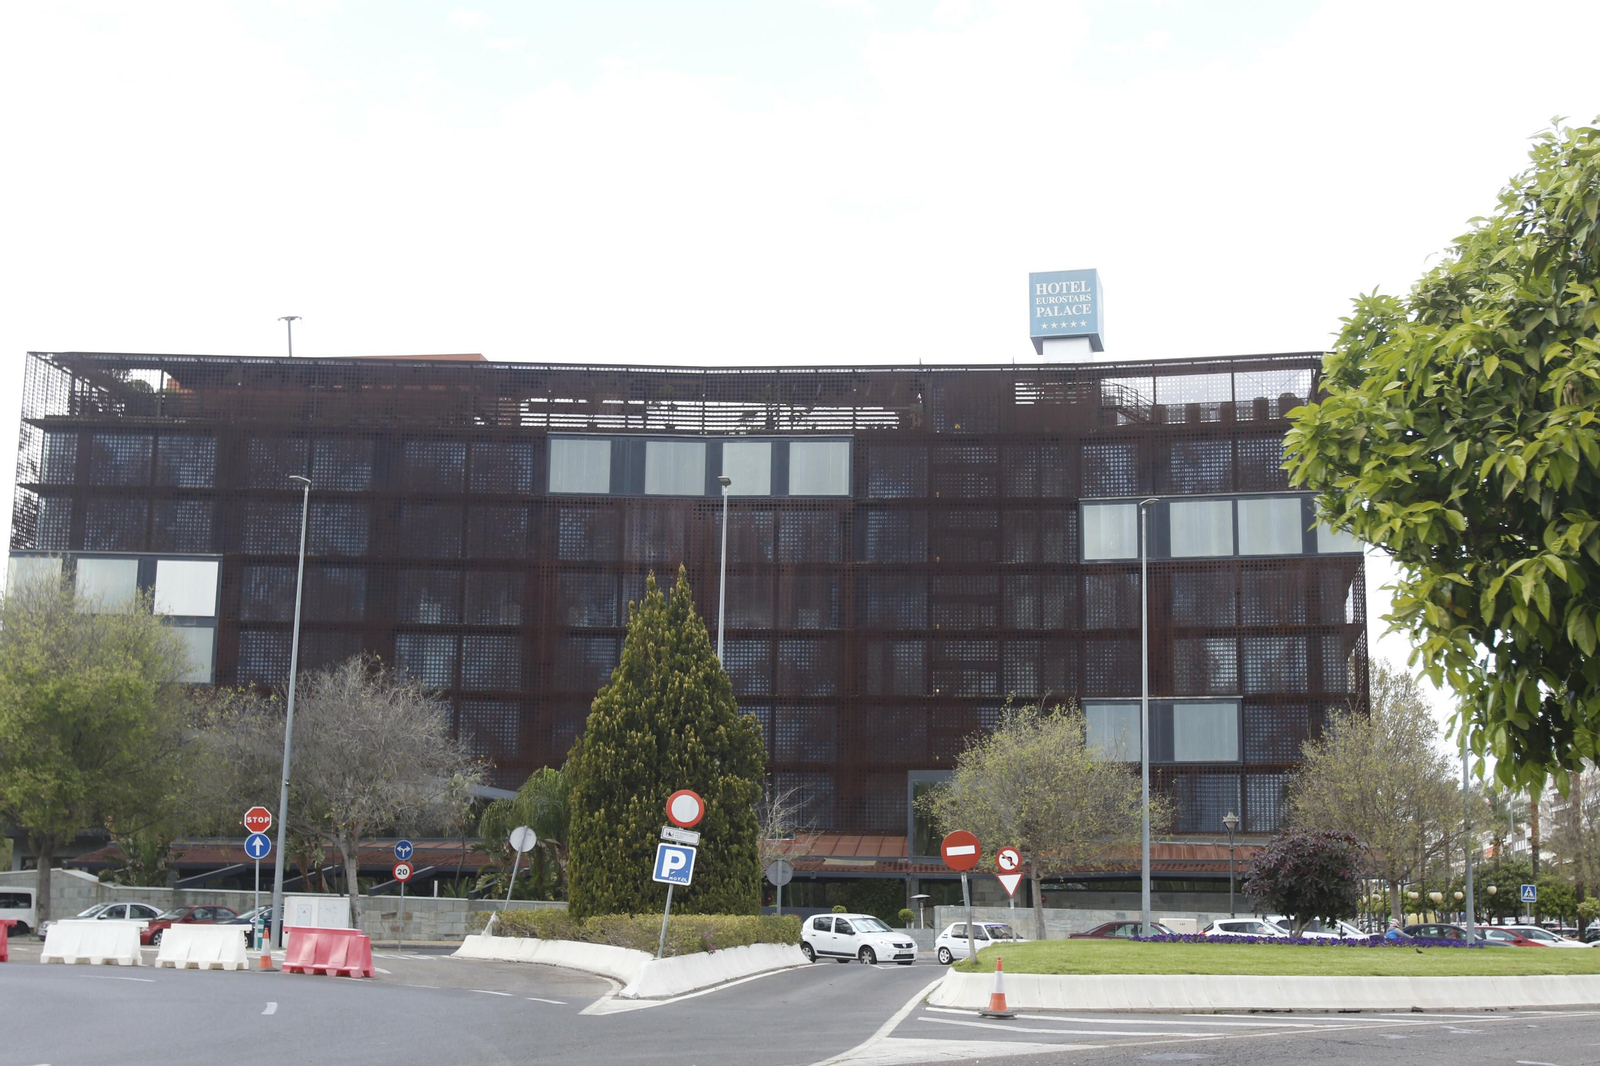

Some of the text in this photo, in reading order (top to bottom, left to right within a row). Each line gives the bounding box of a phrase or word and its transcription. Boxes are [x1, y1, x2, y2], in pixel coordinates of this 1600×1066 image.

[1035, 280, 1091, 295] HOTEL
[1036, 294, 1091, 305] EUROSTARS
[1036, 304, 1091, 317] PALACE
[246, 816, 270, 824] STOP
[661, 849, 686, 878] P
[397, 868, 408, 876] 20
